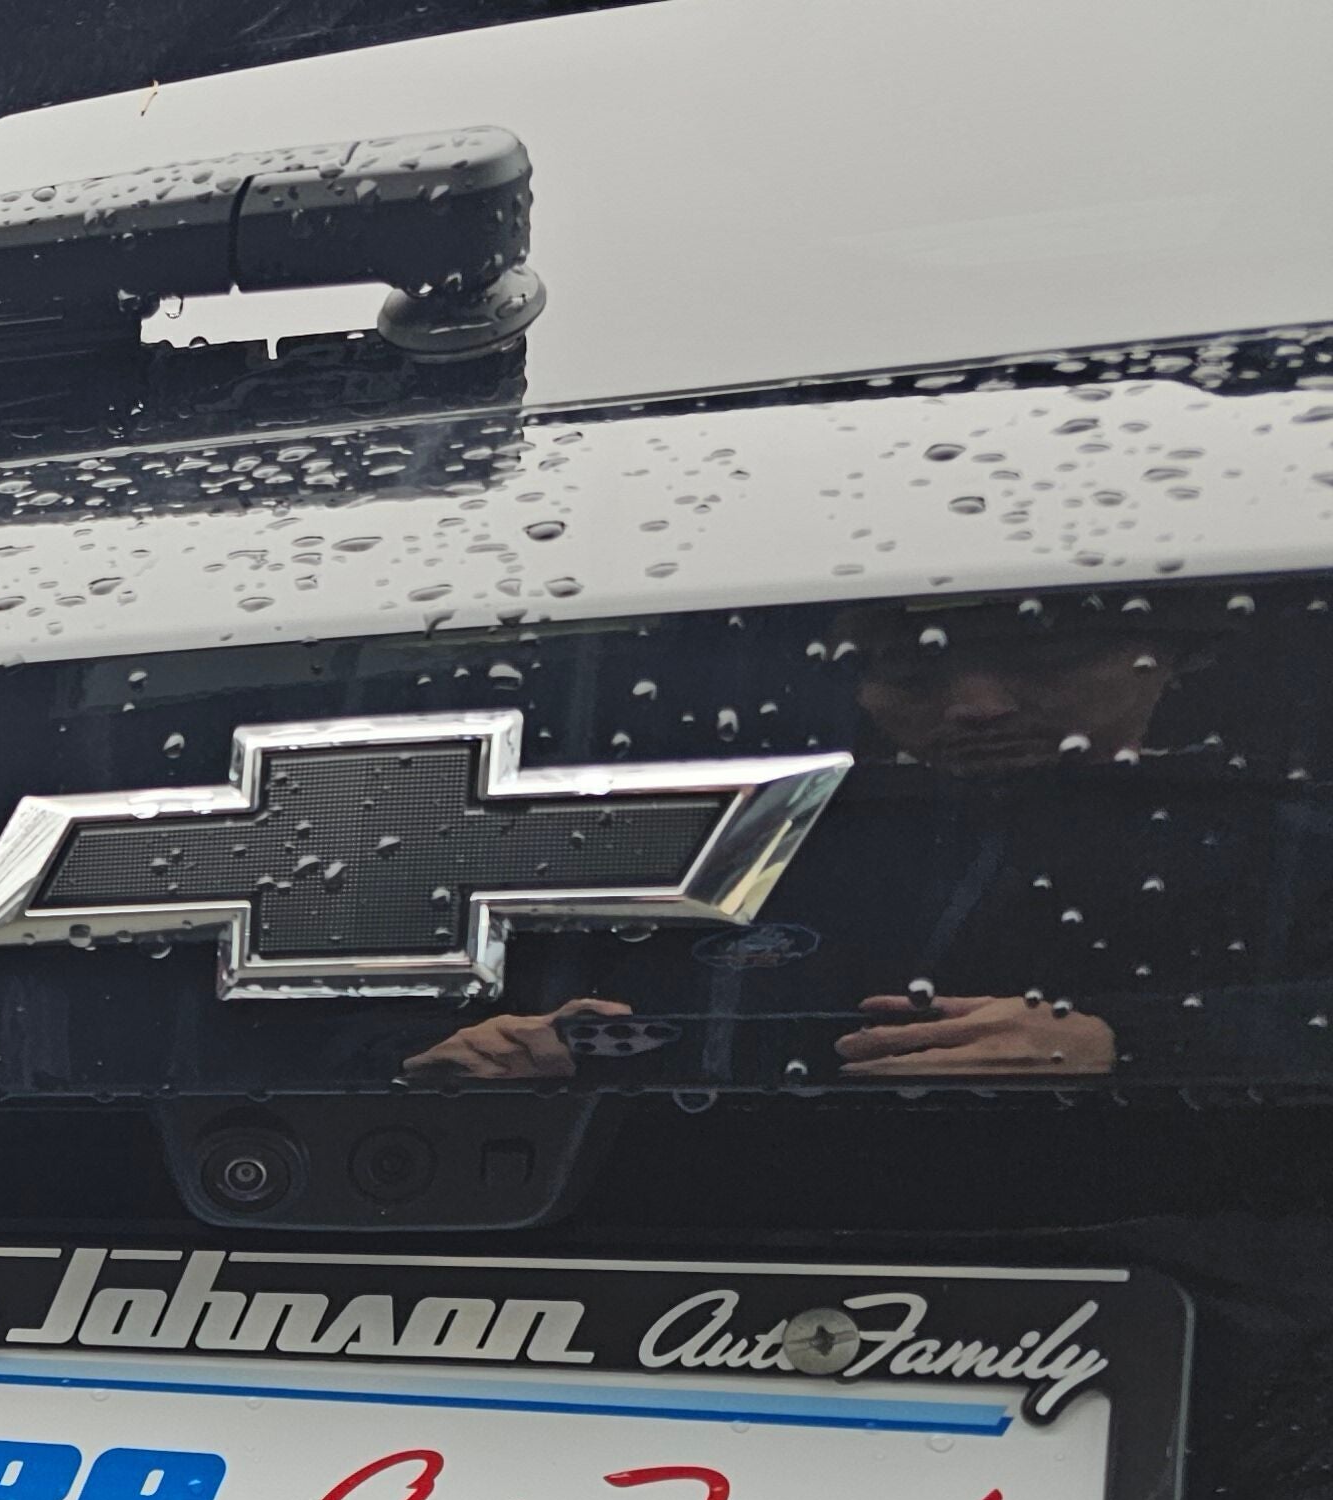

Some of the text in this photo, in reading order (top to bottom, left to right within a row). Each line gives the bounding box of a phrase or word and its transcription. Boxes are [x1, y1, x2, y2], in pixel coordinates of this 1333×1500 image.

[5, 1247, 595, 1363] Johnson
[636, 1288, 823, 1374] Aut
[838, 1292, 1109, 1415] Family
